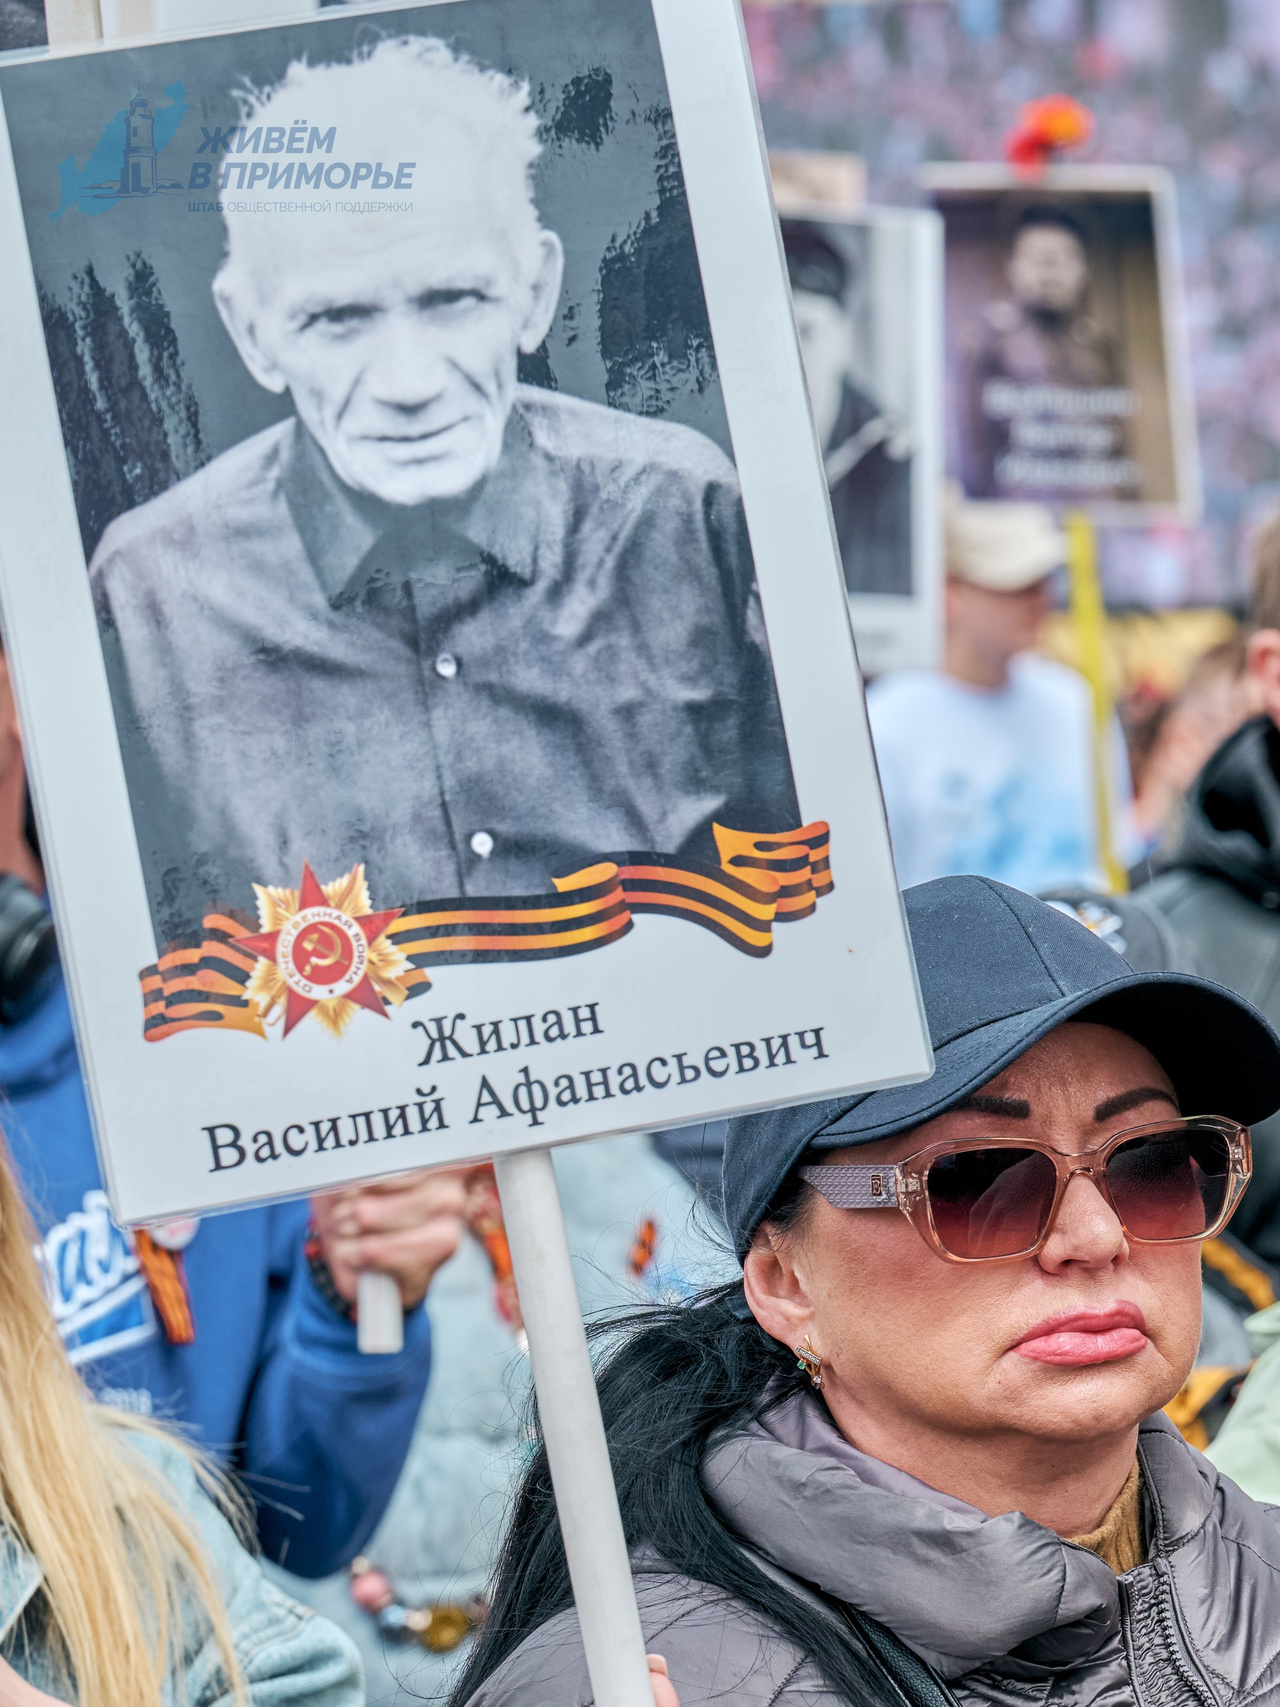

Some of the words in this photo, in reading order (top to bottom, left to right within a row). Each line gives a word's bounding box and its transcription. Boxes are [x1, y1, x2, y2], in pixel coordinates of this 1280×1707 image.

[412, 1003, 604, 1066] Жилан
[202, 1085, 449, 1172] Василий
[469, 1027, 830, 1127] Афанасьевич
